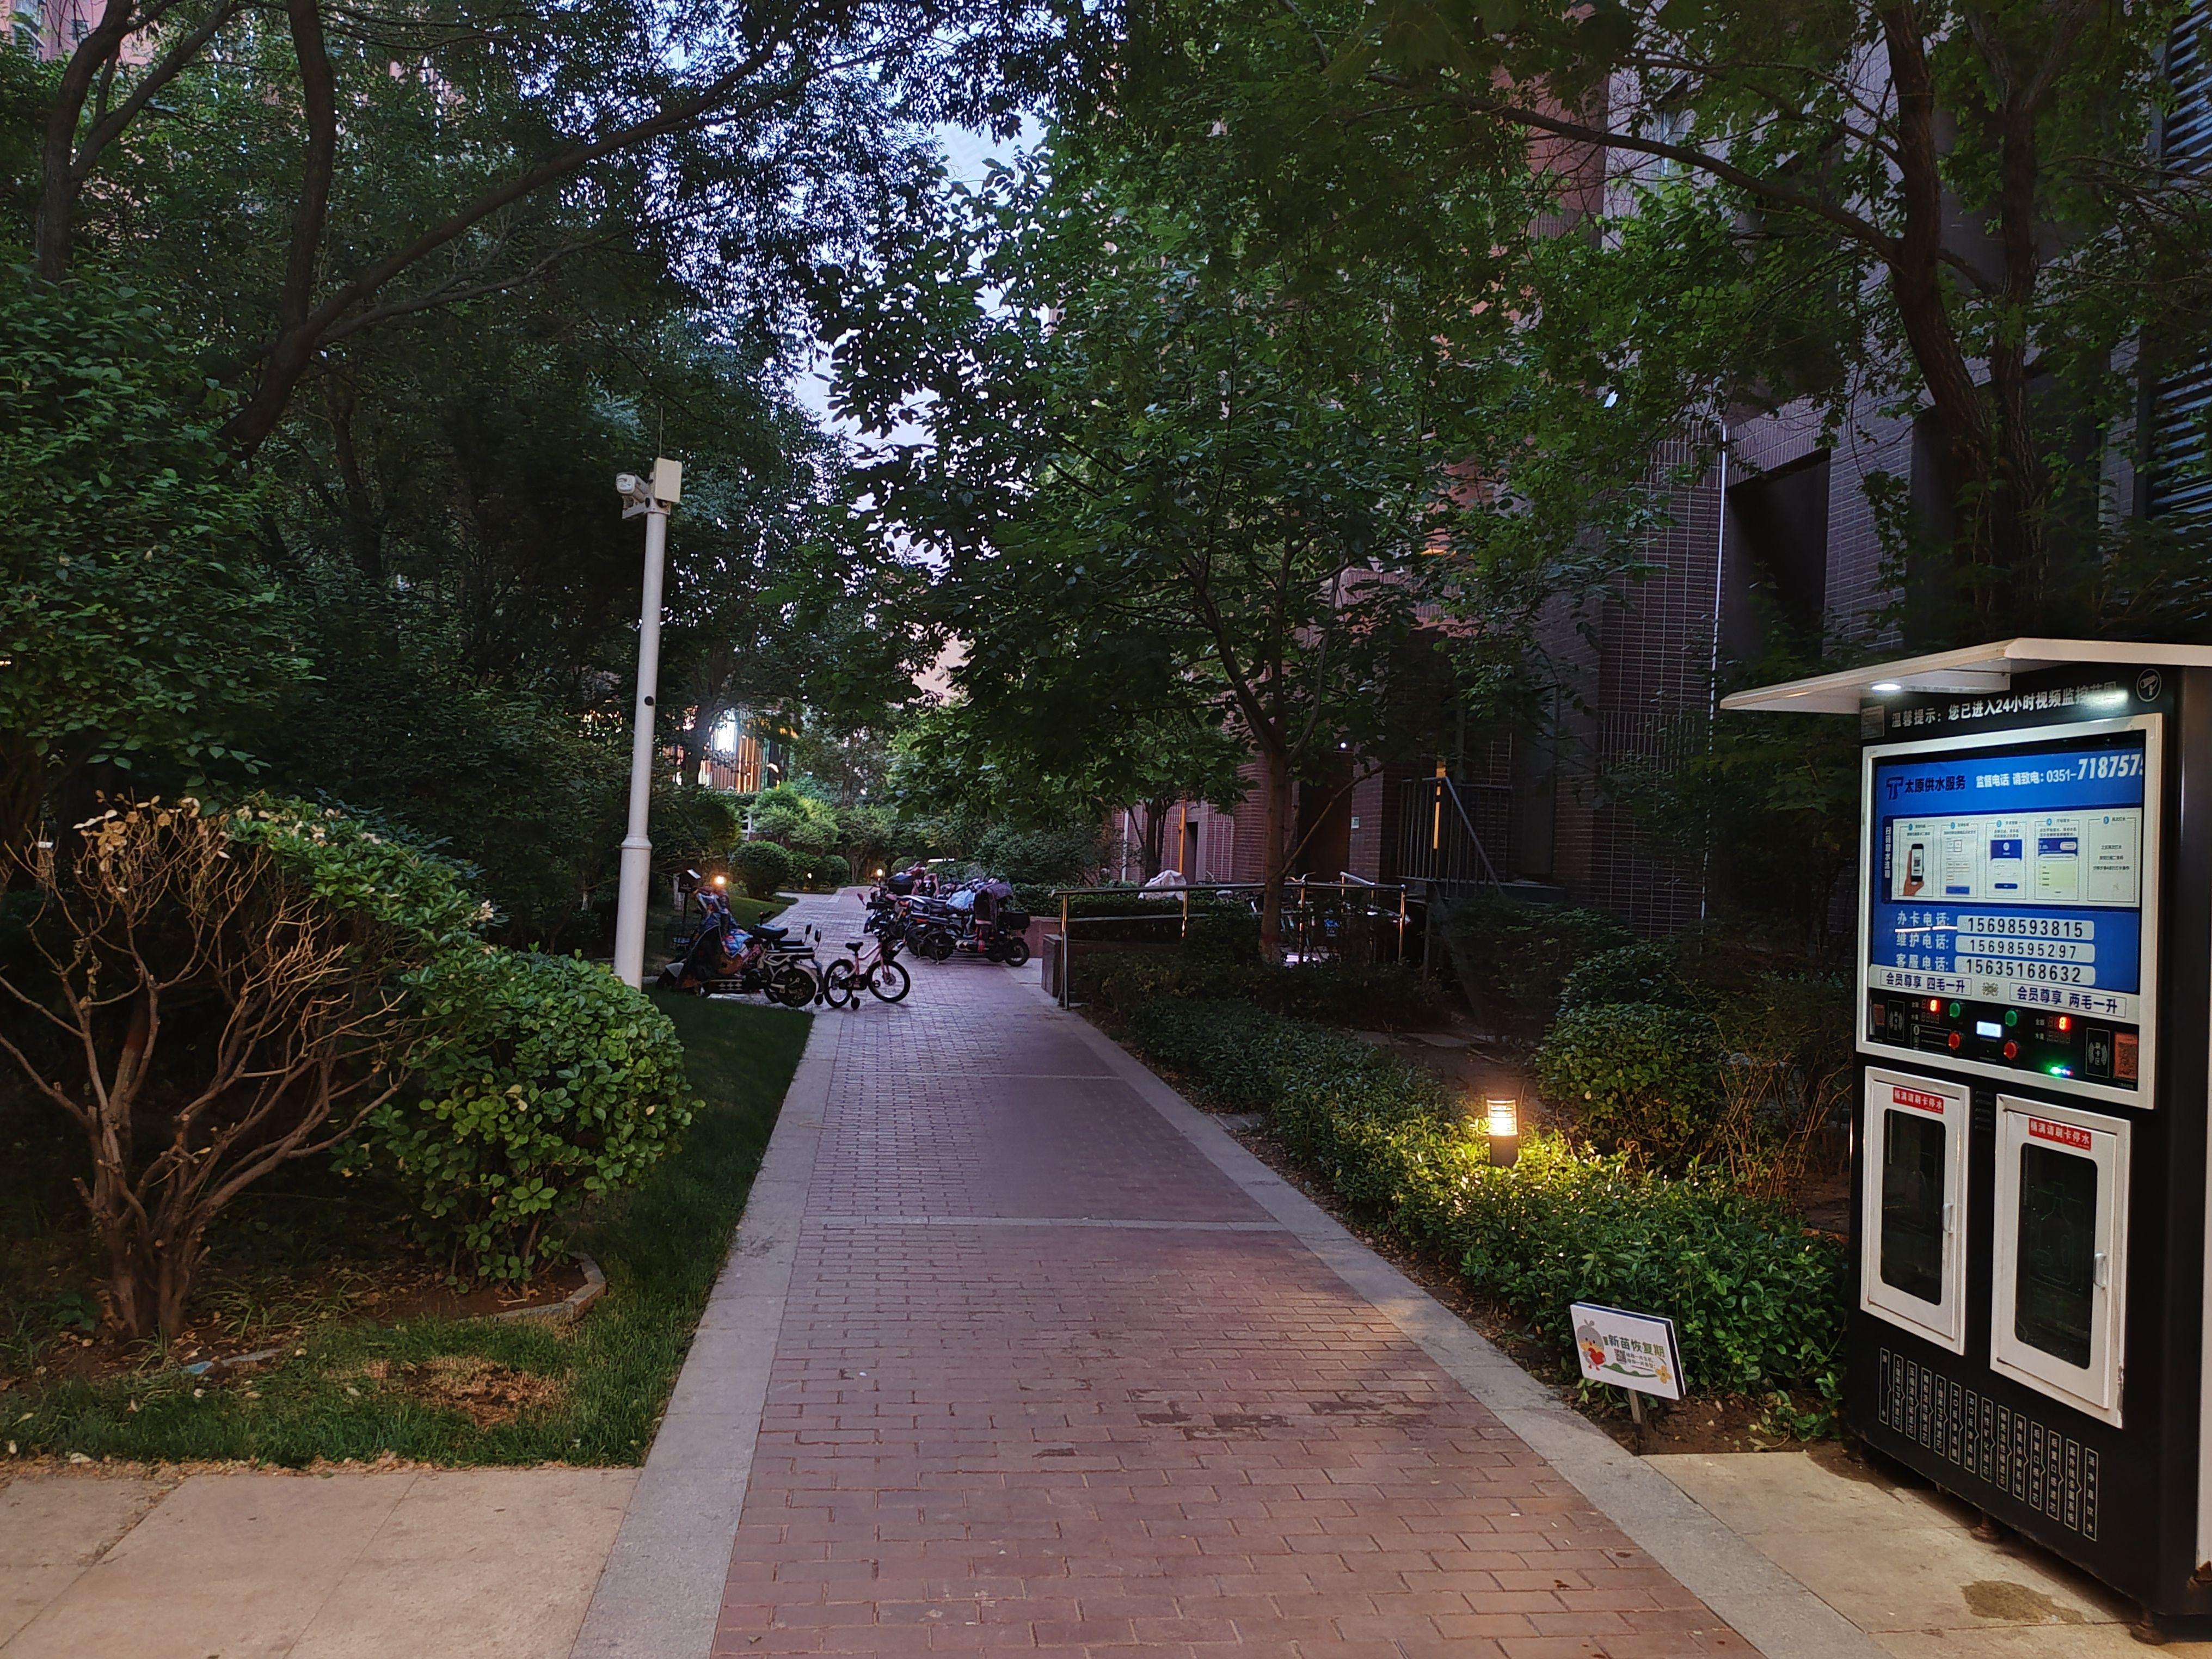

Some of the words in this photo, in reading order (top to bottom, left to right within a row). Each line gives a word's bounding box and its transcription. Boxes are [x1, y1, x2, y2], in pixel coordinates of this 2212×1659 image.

[1976, 773, 2010, 788] 监督电话
[2013, 754, 2143, 785] 请致电：0351-718757
[1905, 776, 1965, 794] 太原供水服务
[1968, 918, 2082, 937] 15698593815
[1970, 939, 2076, 959] 15698595297
[1967, 959, 2080, 983] 15635168632
[1887, 972, 1921, 988] 会员尊享
[1927, 977, 1965, 993] 四毛一升
[2017, 986, 2062, 1005] 会员尊享
[2069, 993, 2117, 1014] 两毛一升
[1608, 1334, 1665, 1358] 新苗恢复期
